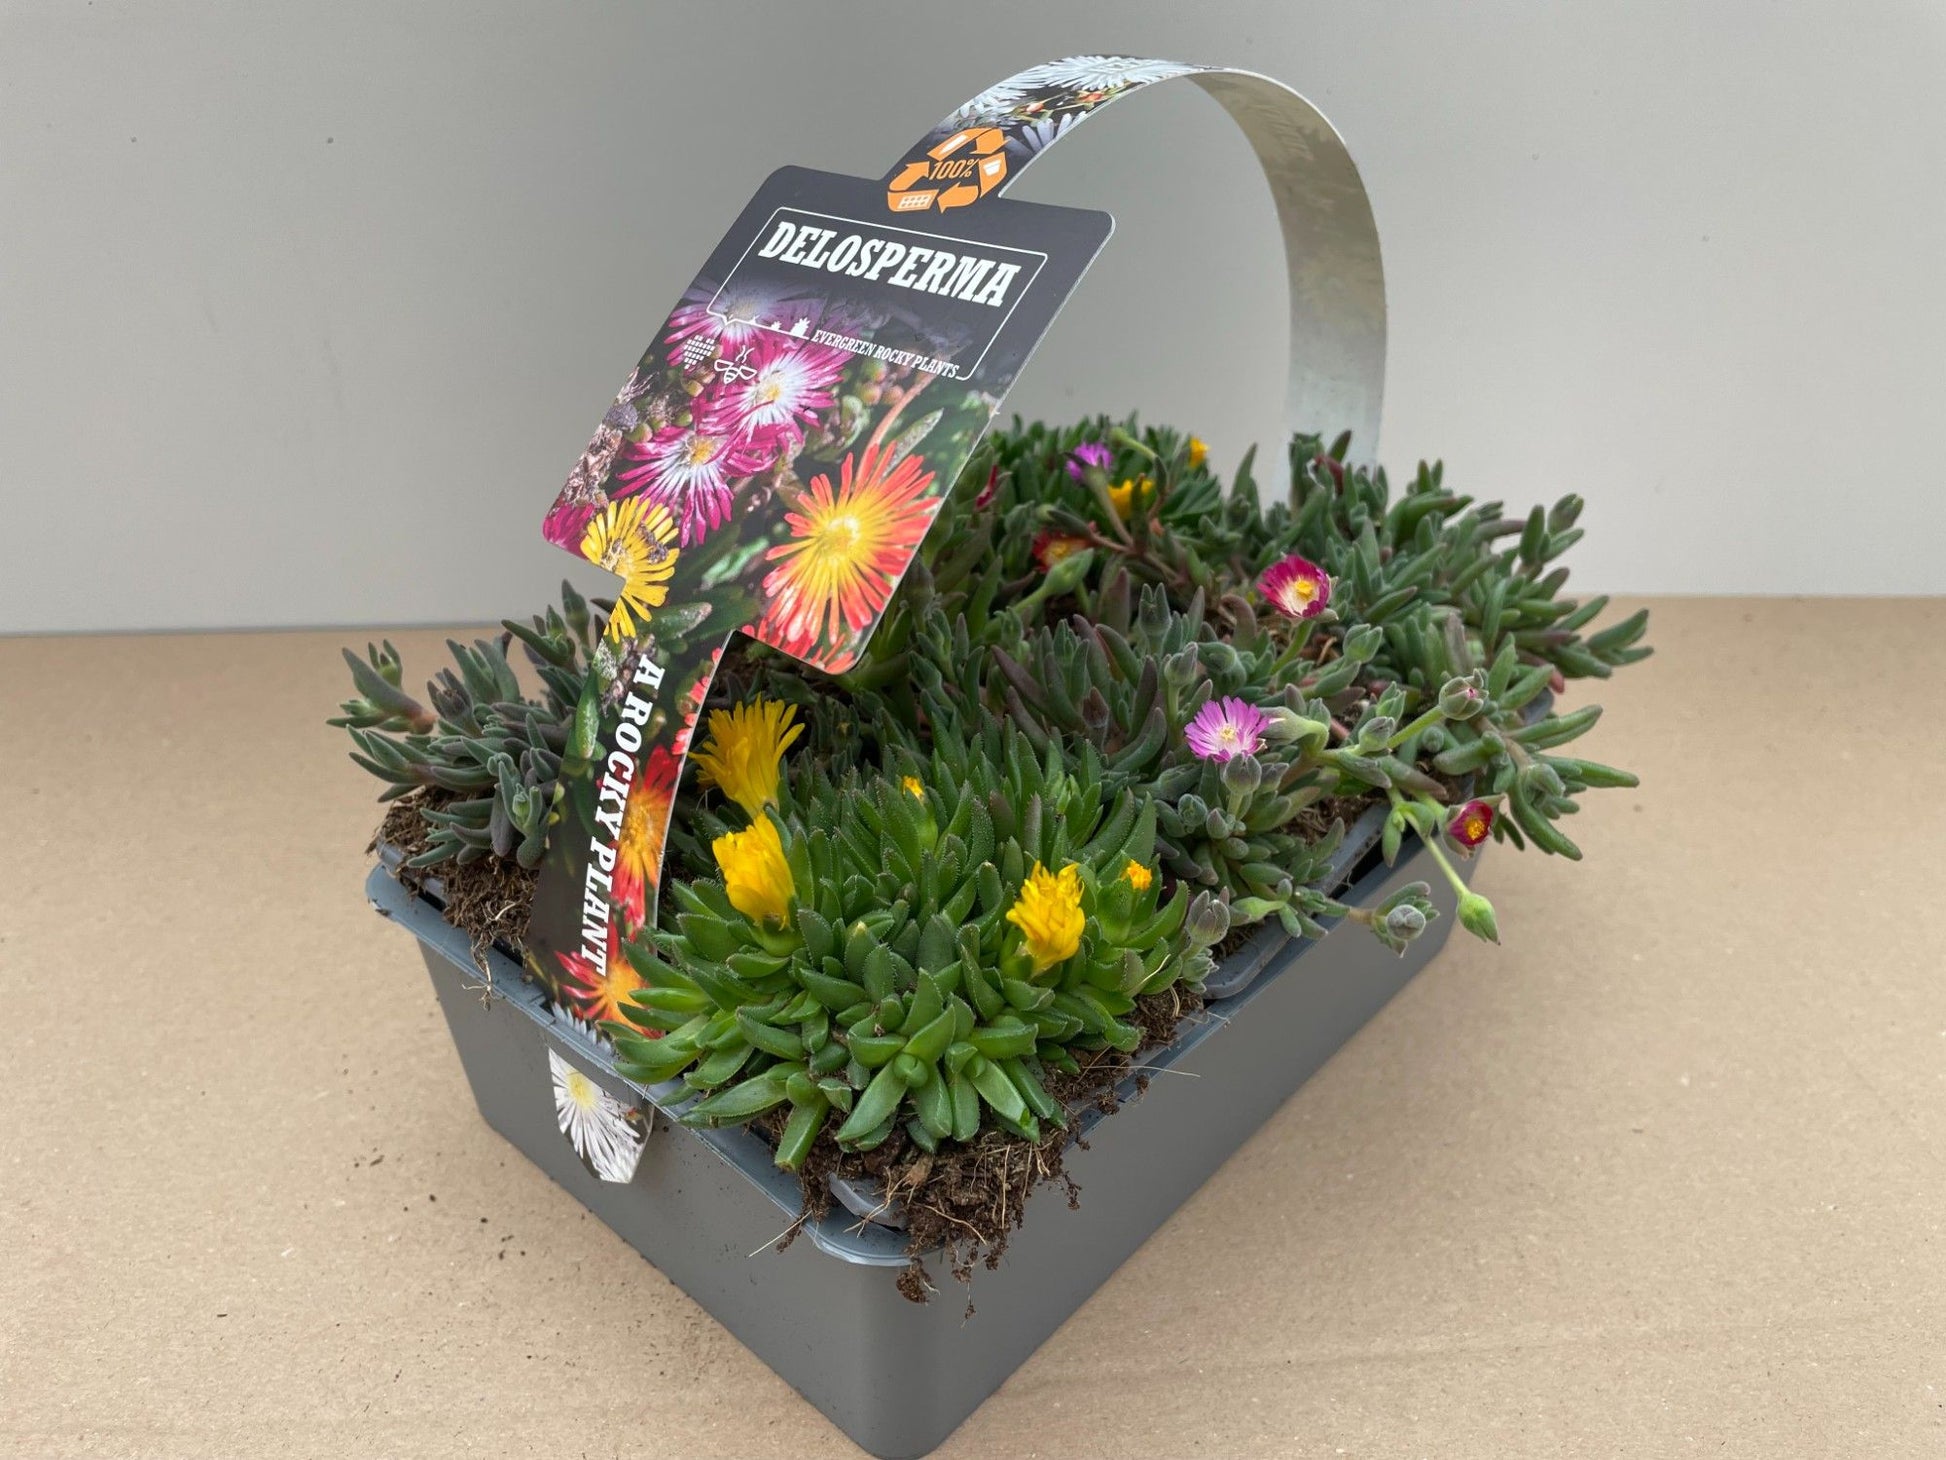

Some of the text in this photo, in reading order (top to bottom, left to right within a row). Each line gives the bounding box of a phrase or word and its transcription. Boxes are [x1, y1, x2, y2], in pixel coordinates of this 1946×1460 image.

[929, 158, 980, 180] 100%
[758, 221, 1022, 307] DELOSPERMA
[811, 330, 960, 378] EVERGREEN ROCKY PLANTS
[581, 654, 665, 977] A ROCKY PLANT
